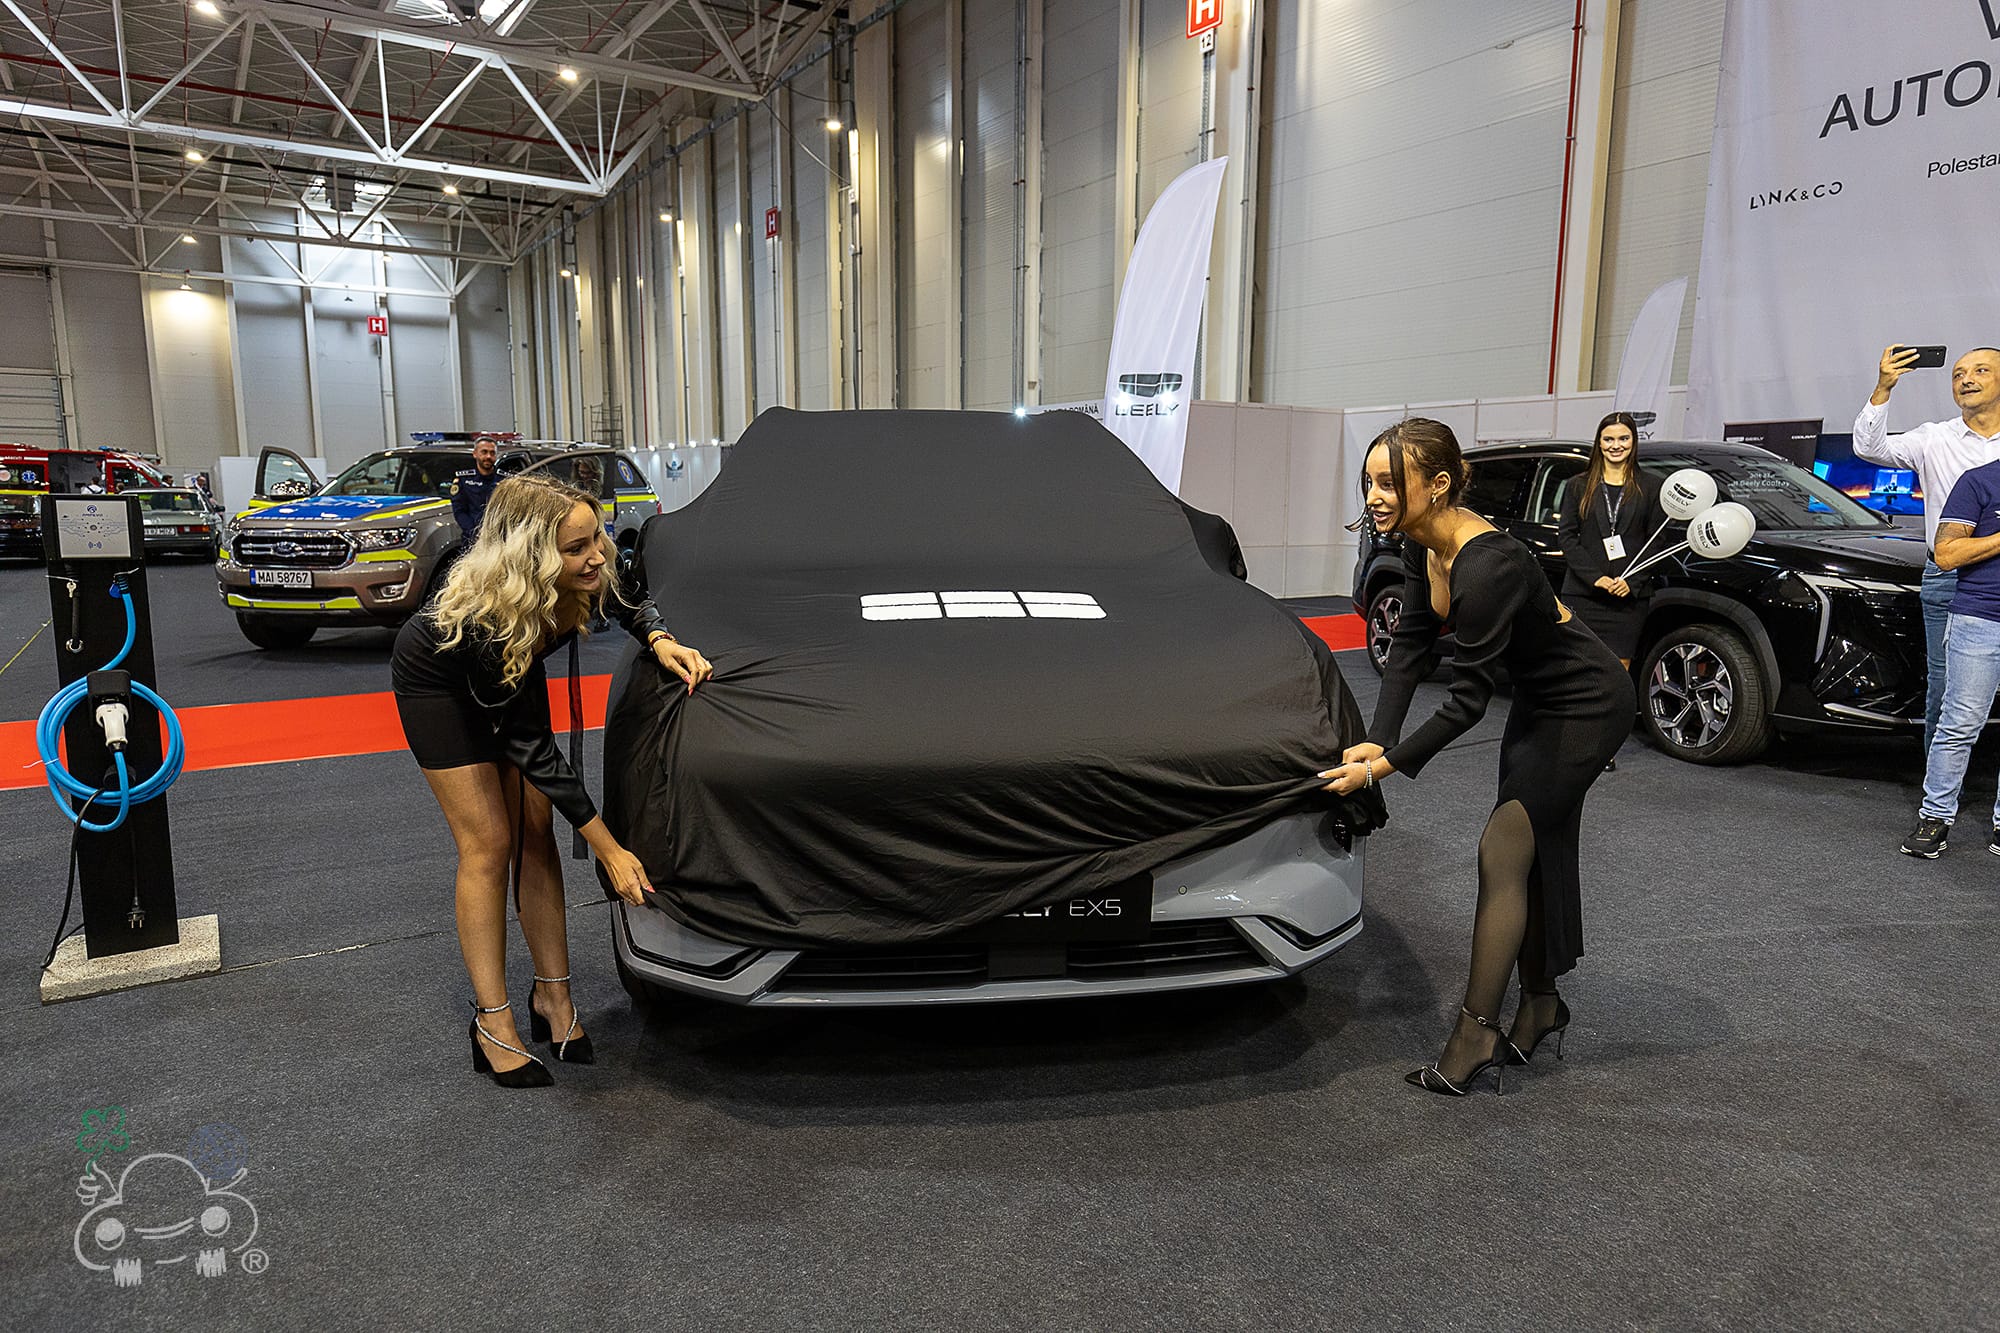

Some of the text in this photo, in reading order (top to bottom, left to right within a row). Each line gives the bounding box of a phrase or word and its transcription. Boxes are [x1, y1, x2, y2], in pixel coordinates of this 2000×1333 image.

[1202, 34, 1212, 49] 12
[1818, 60, 2000, 139] AUTO
[768, 213, 776, 233] H
[371, 319, 384, 332] H
[1666, 489, 1691, 507] GEELY
[1696, 523, 1711, 550] GEELY
[257, 571, 309, 584] MAI 58767
[1069, 898, 1122, 917] EX5
